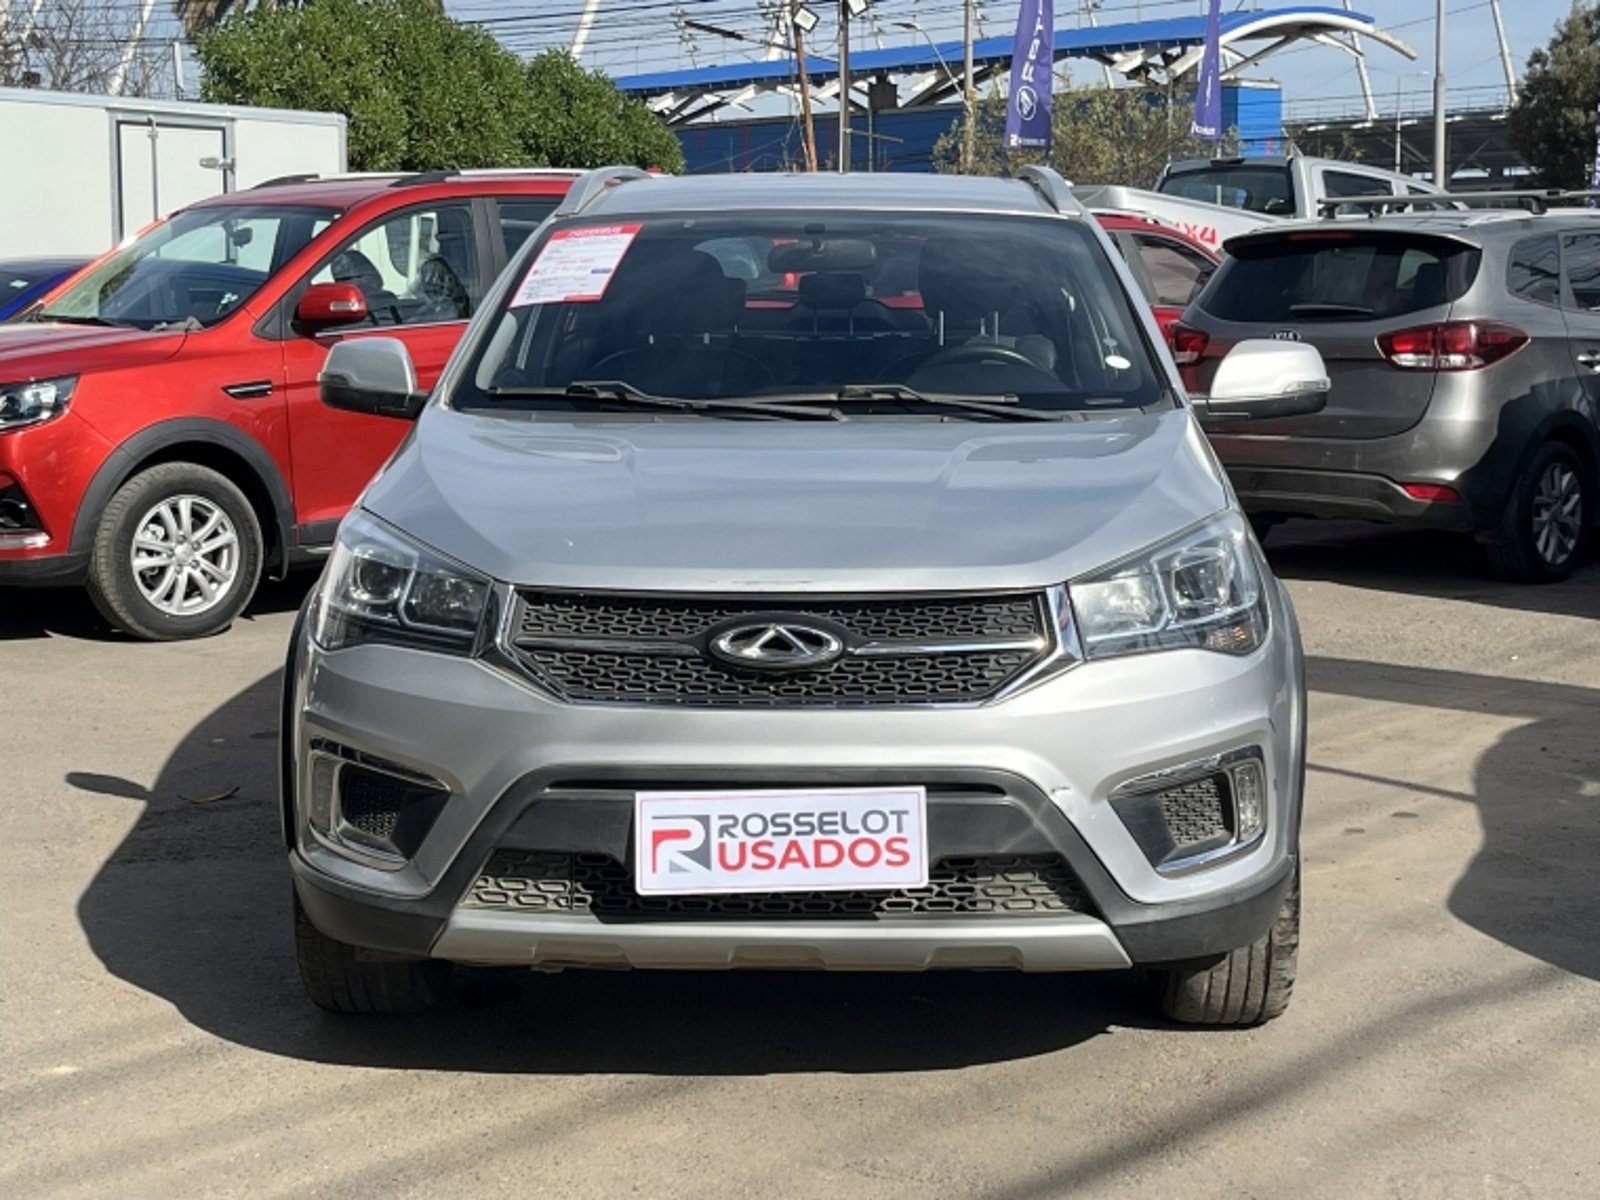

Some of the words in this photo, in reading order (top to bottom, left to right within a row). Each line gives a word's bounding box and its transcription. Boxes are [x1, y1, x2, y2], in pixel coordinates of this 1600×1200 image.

[1174, 222, 1216, 245] X4
[717, 809, 910, 839] ROSSELOT
[717, 837, 911, 872] USADOS
